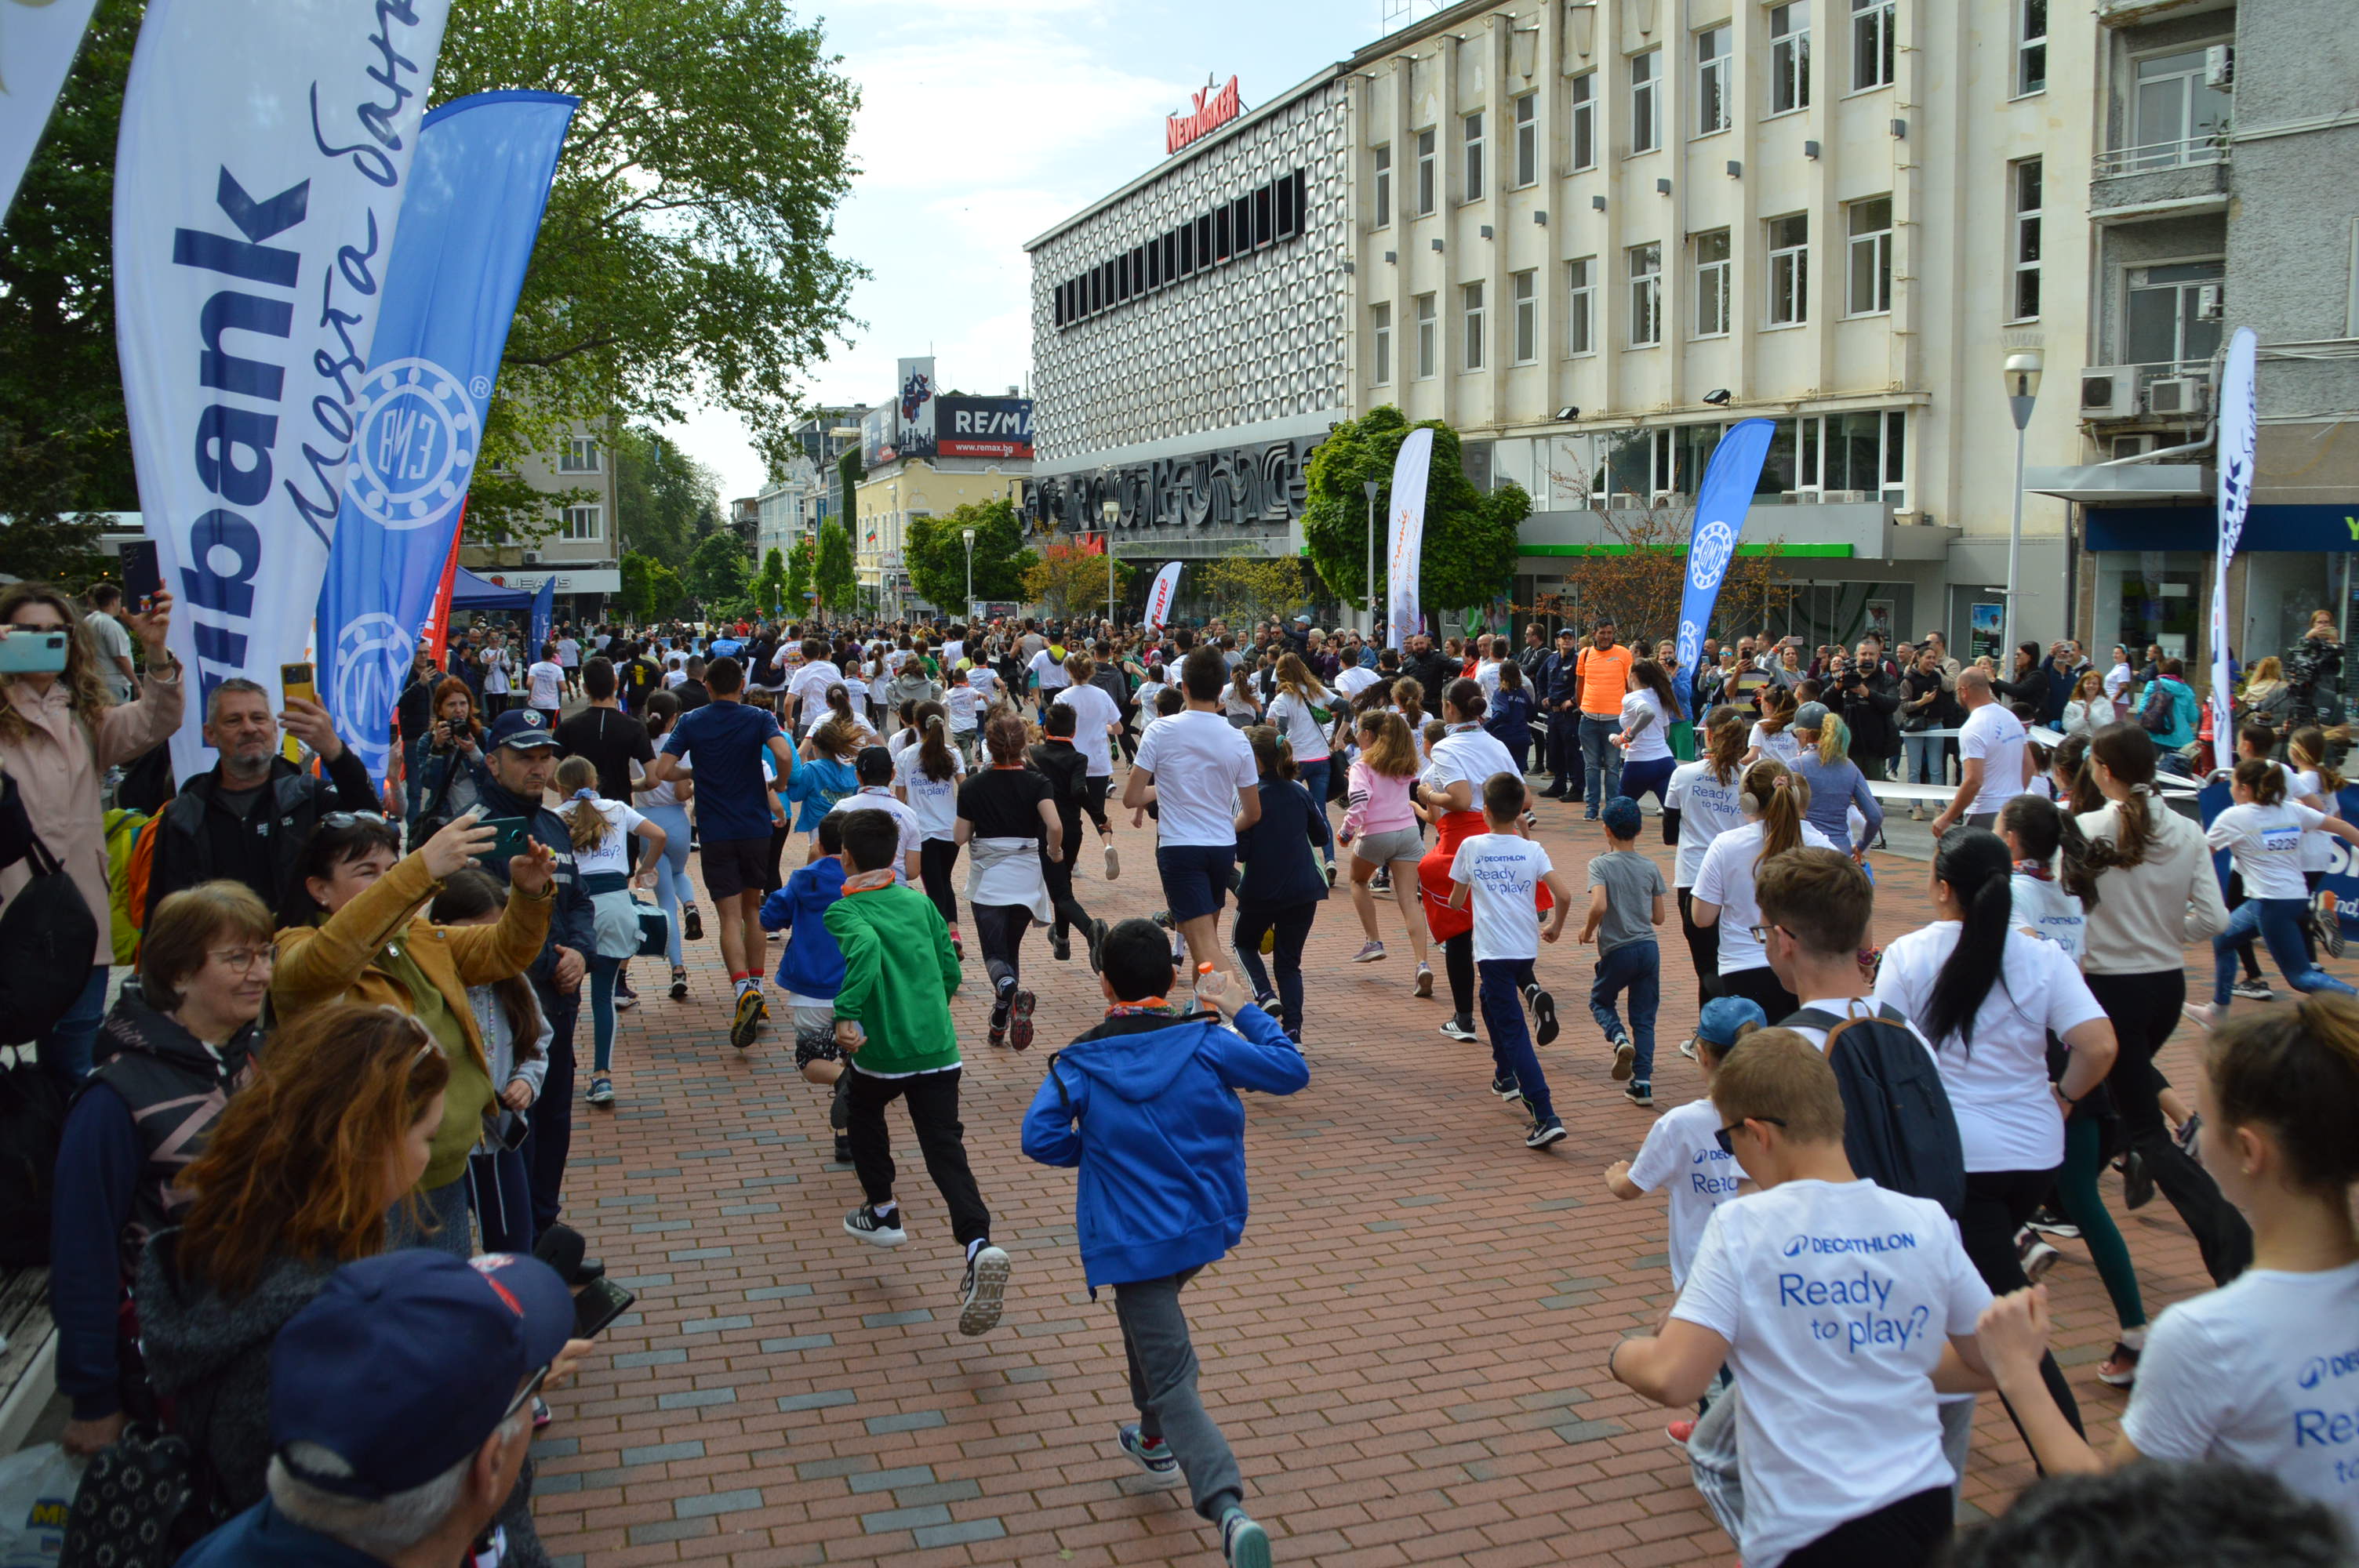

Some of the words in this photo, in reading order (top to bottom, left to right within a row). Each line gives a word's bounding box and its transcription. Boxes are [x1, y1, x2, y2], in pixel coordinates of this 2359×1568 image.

[955, 410, 1035, 434] RE/MA
[955, 444, 1013, 454] www.remax.bg
[927, 784, 950, 797] play?
[1692, 785, 1732, 803] Ready
[2267, 837, 2298, 851] 5229
[1474, 867, 1516, 883] Ready
[1499, 880, 1532, 895] play?
[1812, 1232, 1917, 1254] DECATHLON
[1779, 1270, 1894, 1312] Ready
[1811, 1319, 1839, 1341] to
[1848, 1305, 1930, 1355] play?
